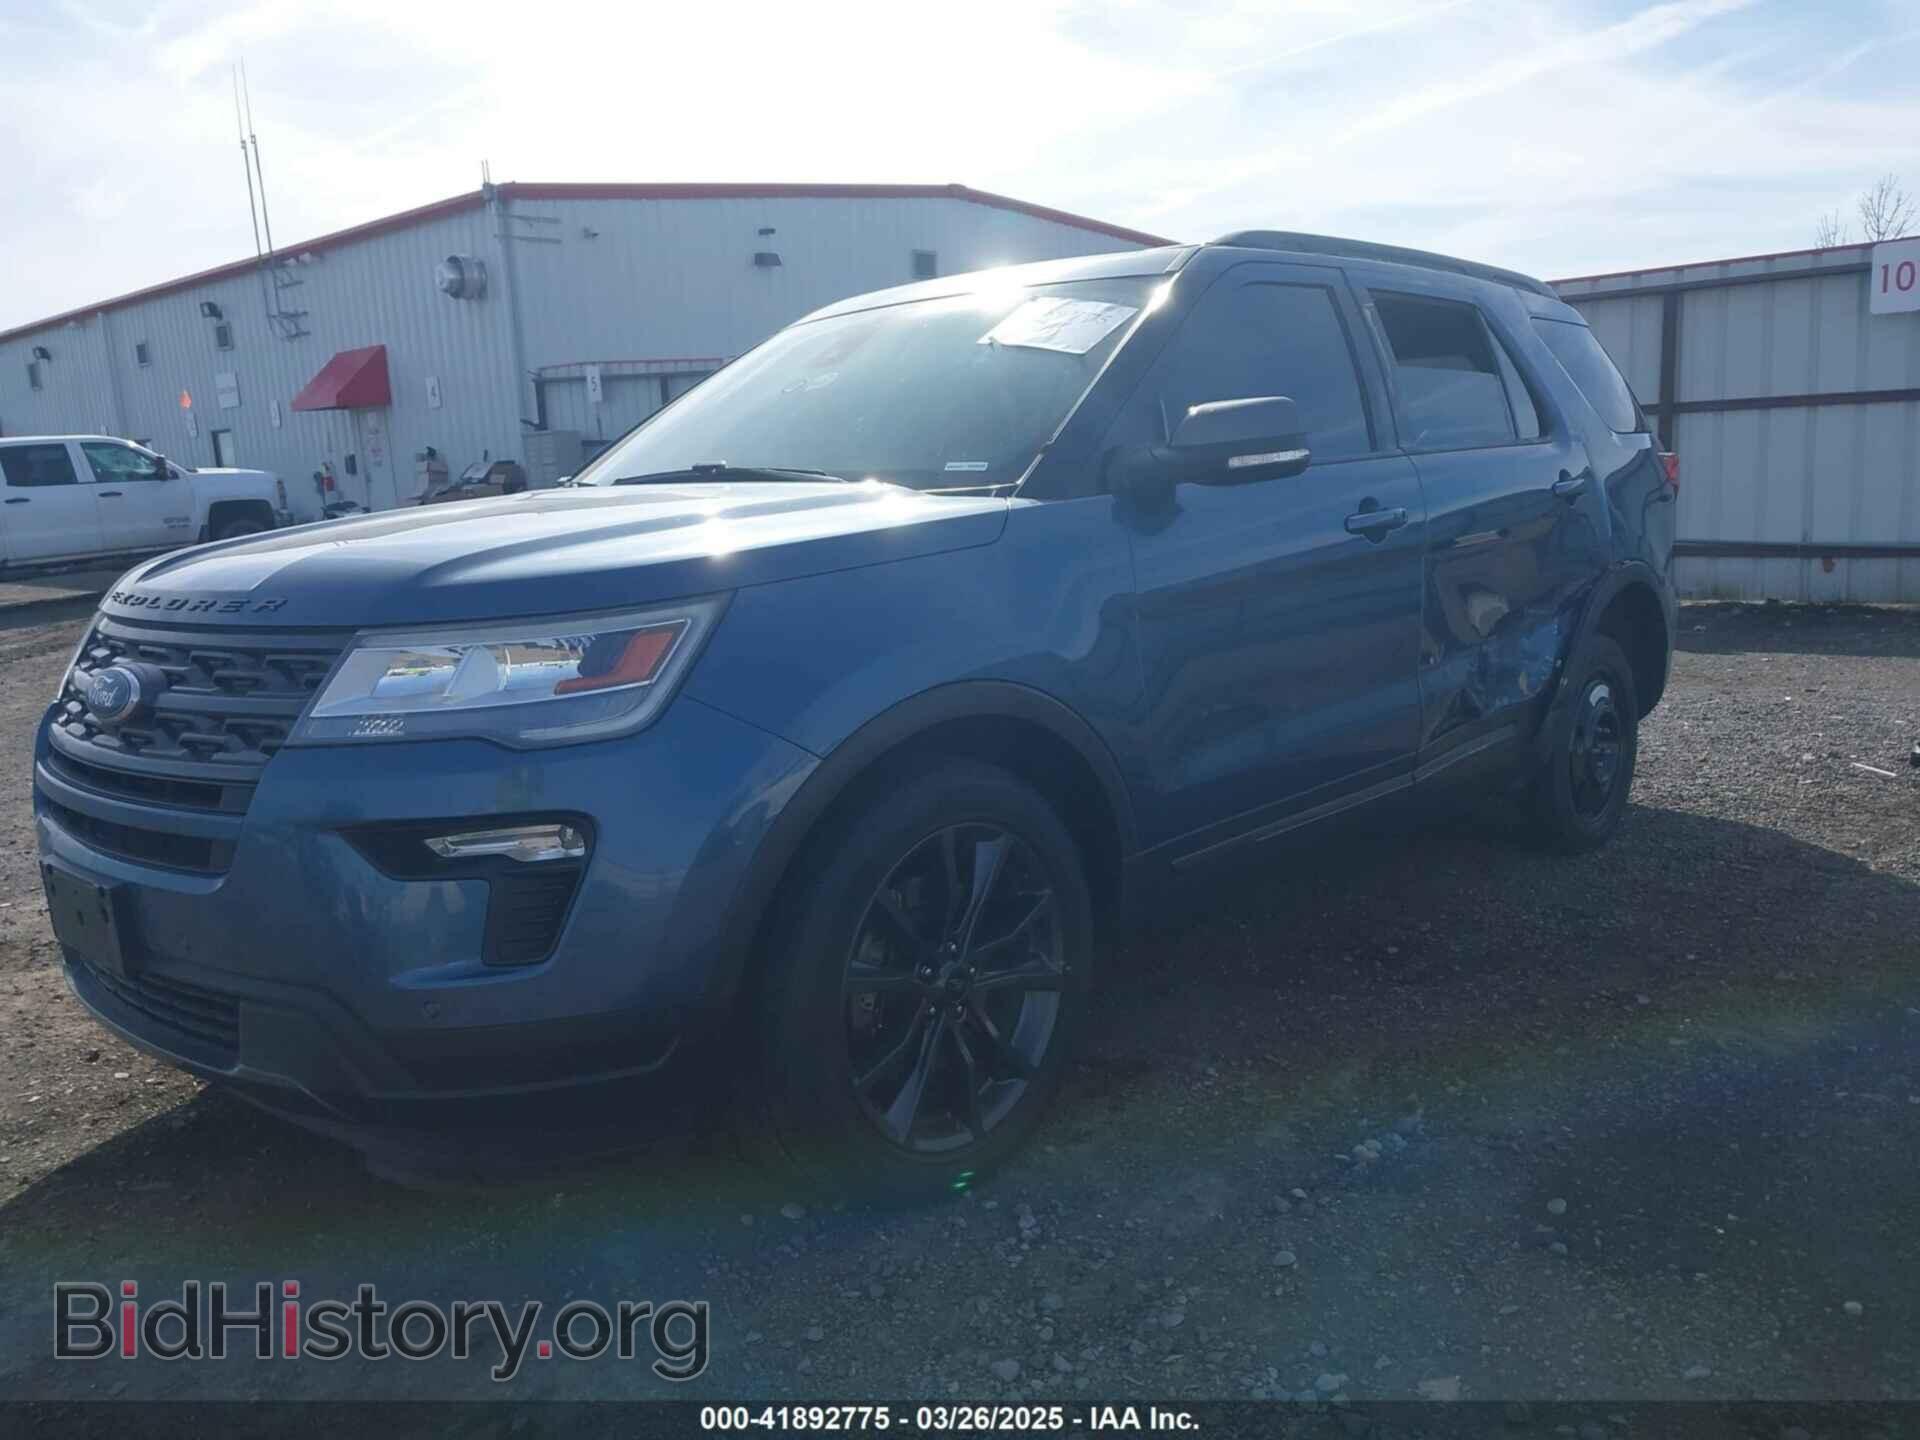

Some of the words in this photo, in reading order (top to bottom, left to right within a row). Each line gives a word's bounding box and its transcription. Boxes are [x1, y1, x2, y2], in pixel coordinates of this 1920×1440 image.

[1881, 261, 1916, 294] 10
[112, 592, 288, 613] EXPLORER
[91, 675, 120, 707] Ford
